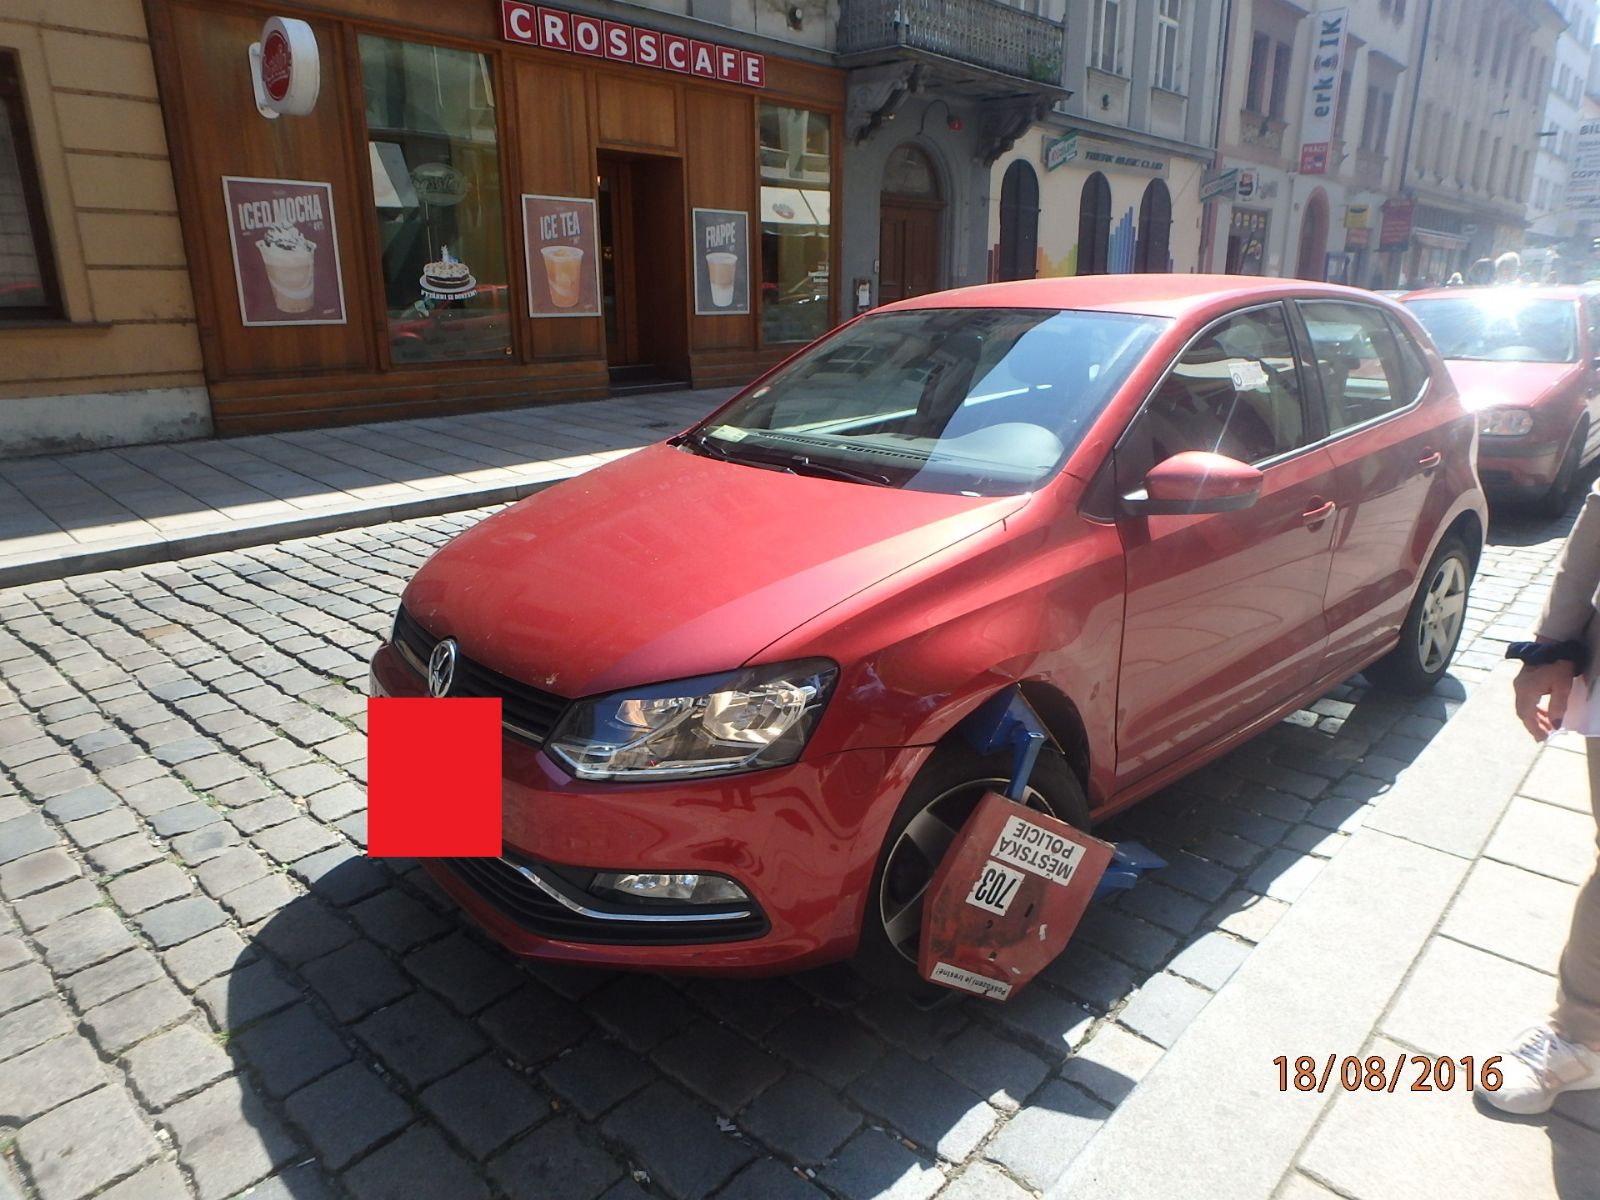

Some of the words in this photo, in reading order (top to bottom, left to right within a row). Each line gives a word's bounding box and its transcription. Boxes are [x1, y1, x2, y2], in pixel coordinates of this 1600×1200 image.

[509, 7, 761, 83] CROSSCAFE
[237, 200, 273, 231] ICED
[272, 193, 323, 226] MOCHA
[539, 214, 558, 241] ICE
[559, 210, 581, 237] TEA
[994, 836, 1074, 880] MĚSTSKÁ
[1012, 822, 1075, 859] POLICIE
[974, 867, 1017, 909] 703
